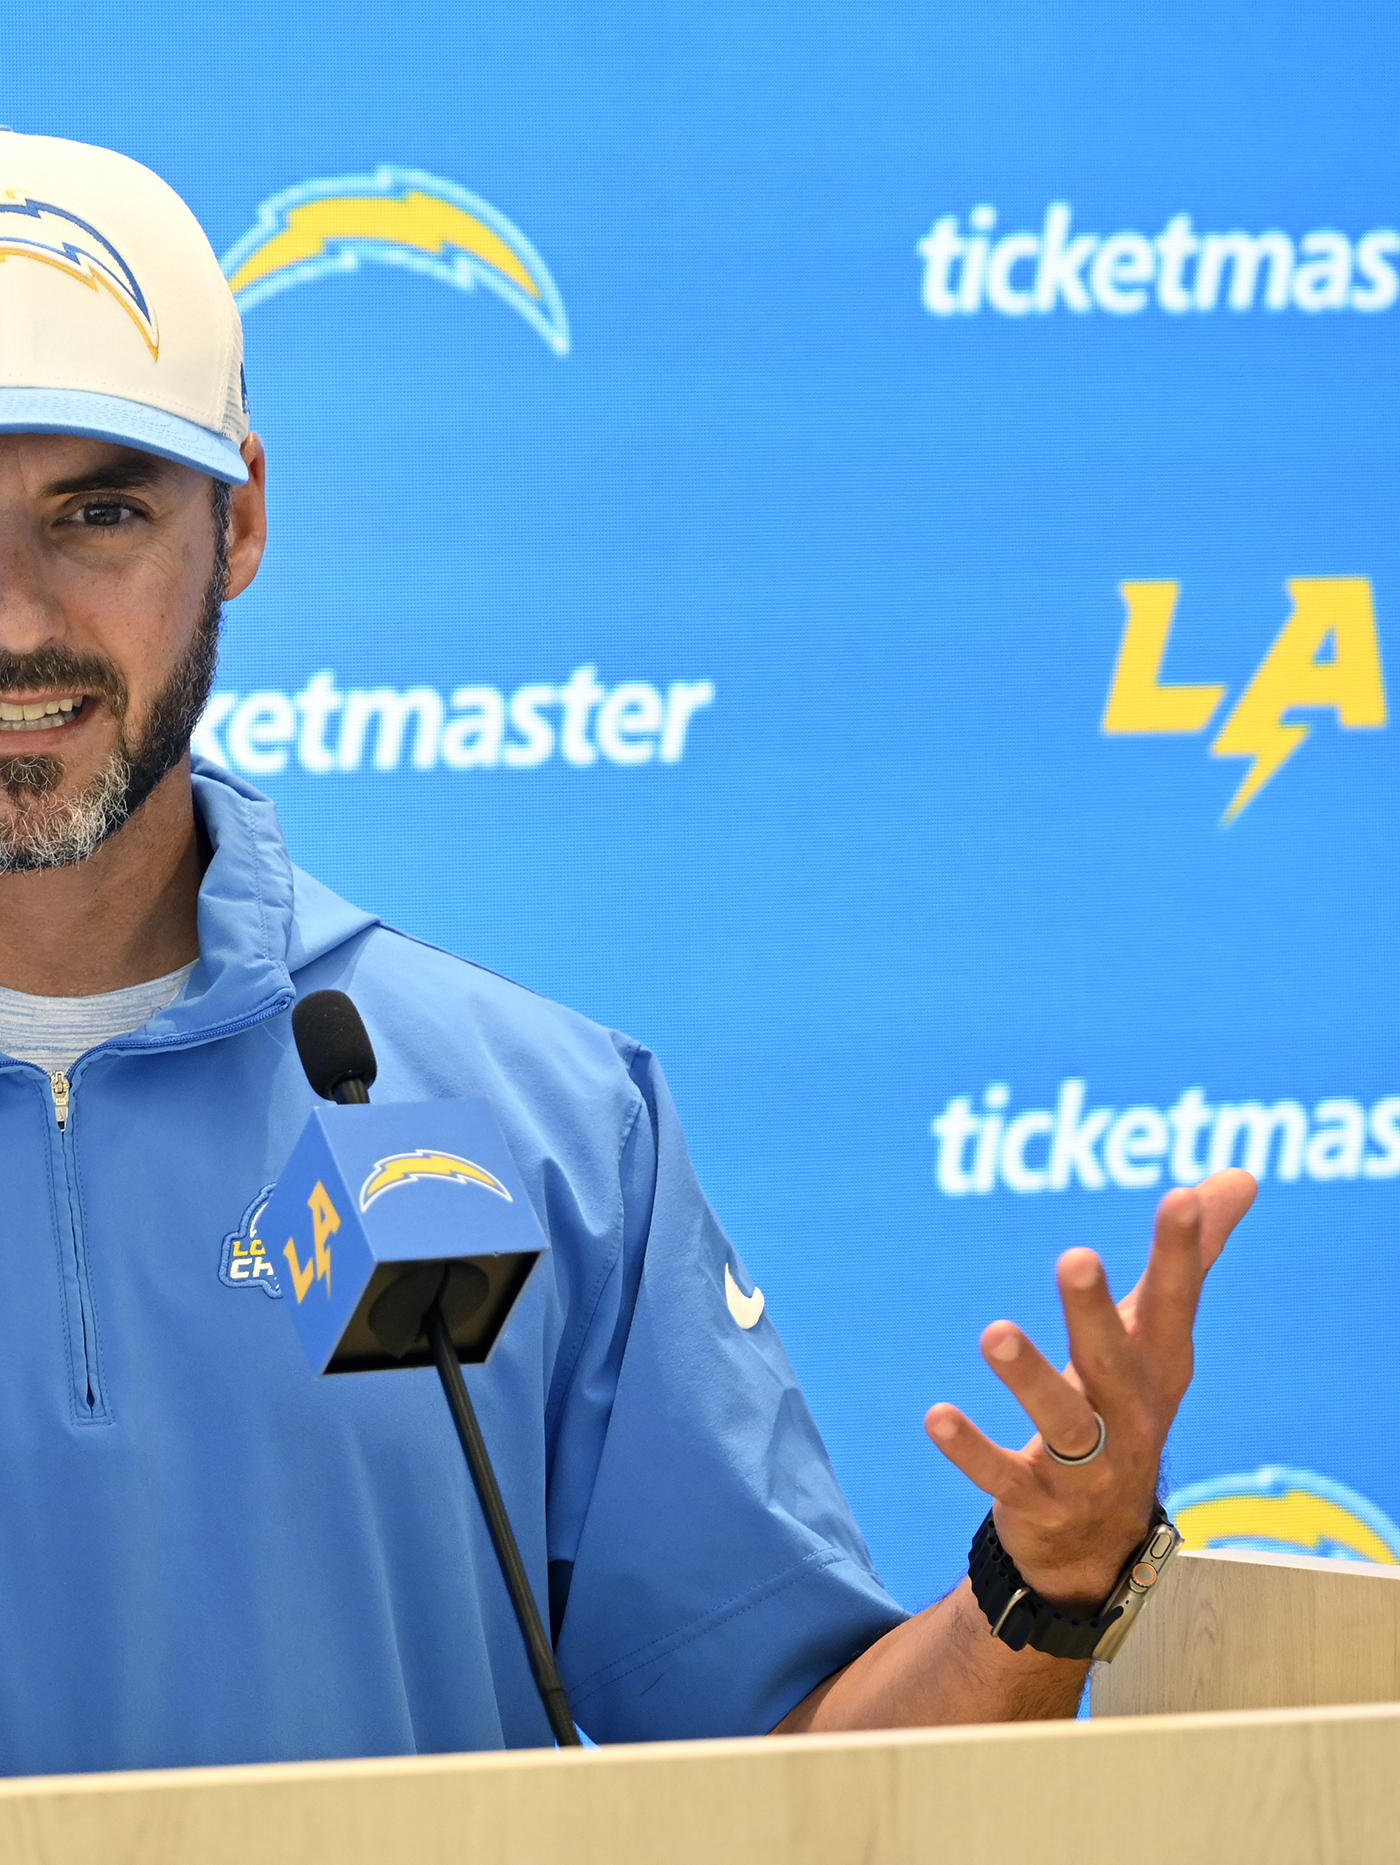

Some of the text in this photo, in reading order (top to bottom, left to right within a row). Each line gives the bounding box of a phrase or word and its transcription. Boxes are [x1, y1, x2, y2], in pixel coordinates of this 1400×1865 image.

[918, 202, 1400, 314] ticketmas
[1102, 575, 1388, 825] LA
[932, 1078, 1400, 1195] ticketmas
[283, 1180, 341, 1304] LA
